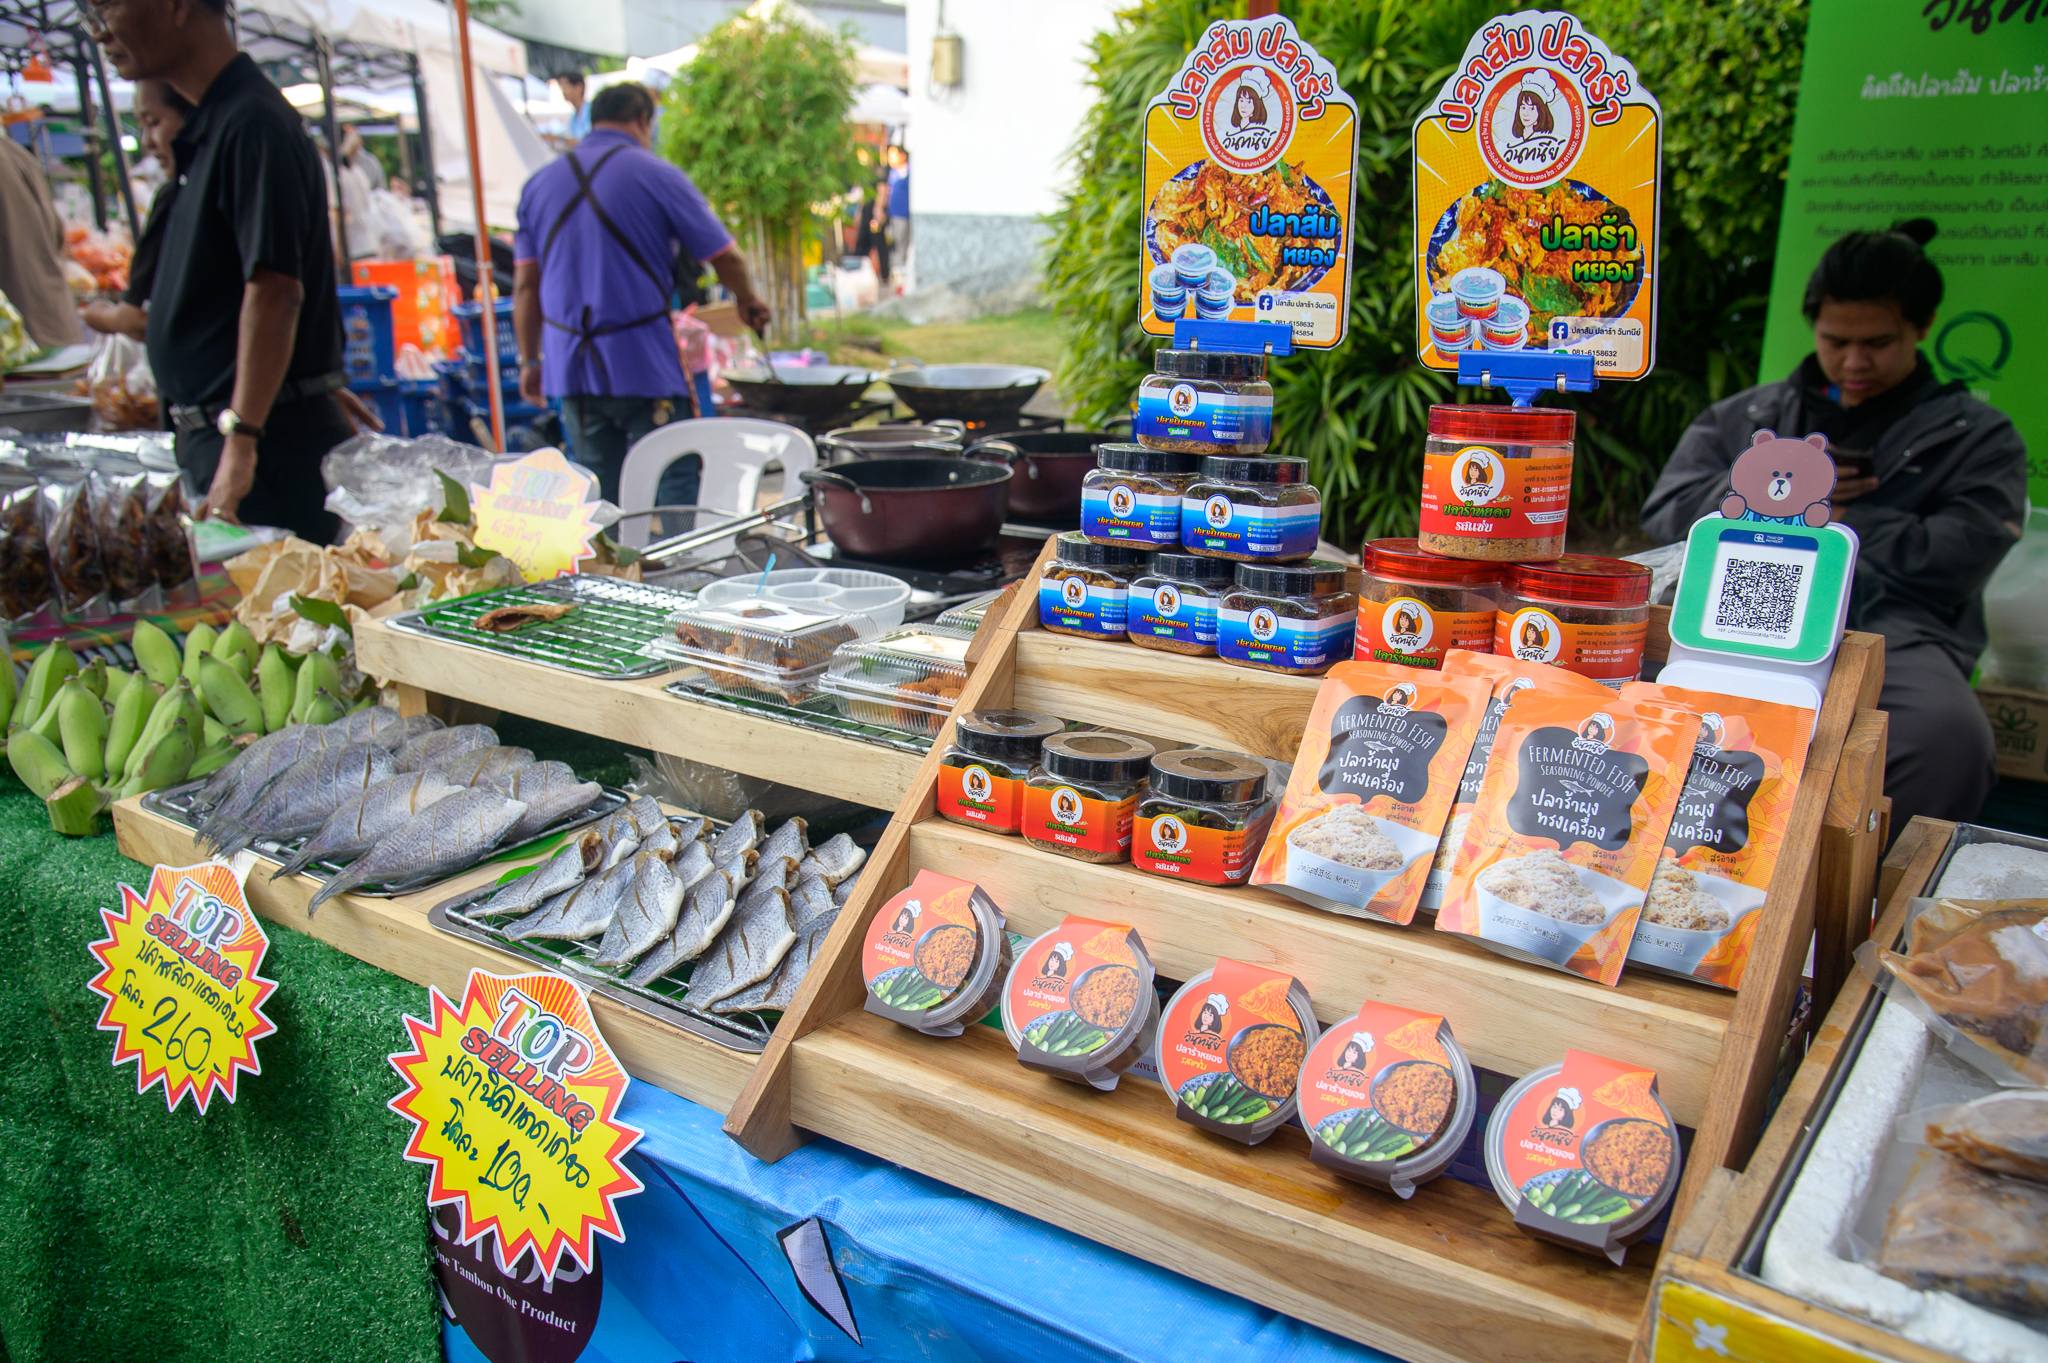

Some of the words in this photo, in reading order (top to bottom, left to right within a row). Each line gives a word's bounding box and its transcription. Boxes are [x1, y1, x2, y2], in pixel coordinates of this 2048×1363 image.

[1169, 24, 1252, 119] ปลาส้ม
[1256, 22, 1334, 120] ปลาร้า
[1440, 23, 1534, 132] ปลาส้ม
[1537, 17, 1631, 125] ปลาร้า
[1503, 136, 1566, 164] วันทนีย์
[1249, 204, 1337, 240] ปลาส้ม
[1540, 214, 1638, 251] ปลาร้า
[1283, 247, 1336, 268] หยอง
[1571, 260, 1635, 284] หยอง
[1459, 484, 1494, 498] วันทนีย์
[1340, 713, 1407, 734] FERMENTED
[1407, 723, 1435, 750] FISH
[1348, 729, 1388, 741] SEASONING
[1388, 733, 1415, 754] POWDER
[1339, 750, 1400, 771] ปลาร้าผง
[1529, 745, 1606, 775] FERMENTED
[1606, 765, 1636, 794] FISH
[1342, 768, 1405, 794] ทรงเครื่อง
[1540, 764, 1585, 781] SEASONING
[1585, 774, 1616, 798] POWDER
[1698, 774, 1730, 798] POWDER
[1720, 764, 1752, 791] FISH
[1531, 788, 1600, 816] ปลาร้าผง
[1678, 794, 1715, 817] ร้าผง
[1537, 812, 1606, 841] ทรงเครื่อง
[1670, 816, 1723, 844] งเครื่อง
[1710, 853, 1737, 865] สะอาด
[170, 878, 243, 946] TOP
[145, 913, 243, 991] SELLING
[496, 989, 592, 1078] TOP
[1175, 1043, 1223, 1064] ปลาร้าหยอง
[461, 1027, 595, 1133] SELLING
[1315, 1080, 1366, 1100] ปลาร้าหยอง
[1519, 1139, 1575, 1161] ปลาร้าหยอง
[452, 1257, 494, 1295] Tambon
[497, 1285, 518, 1309] One
[521, 1299, 577, 1334] Product
